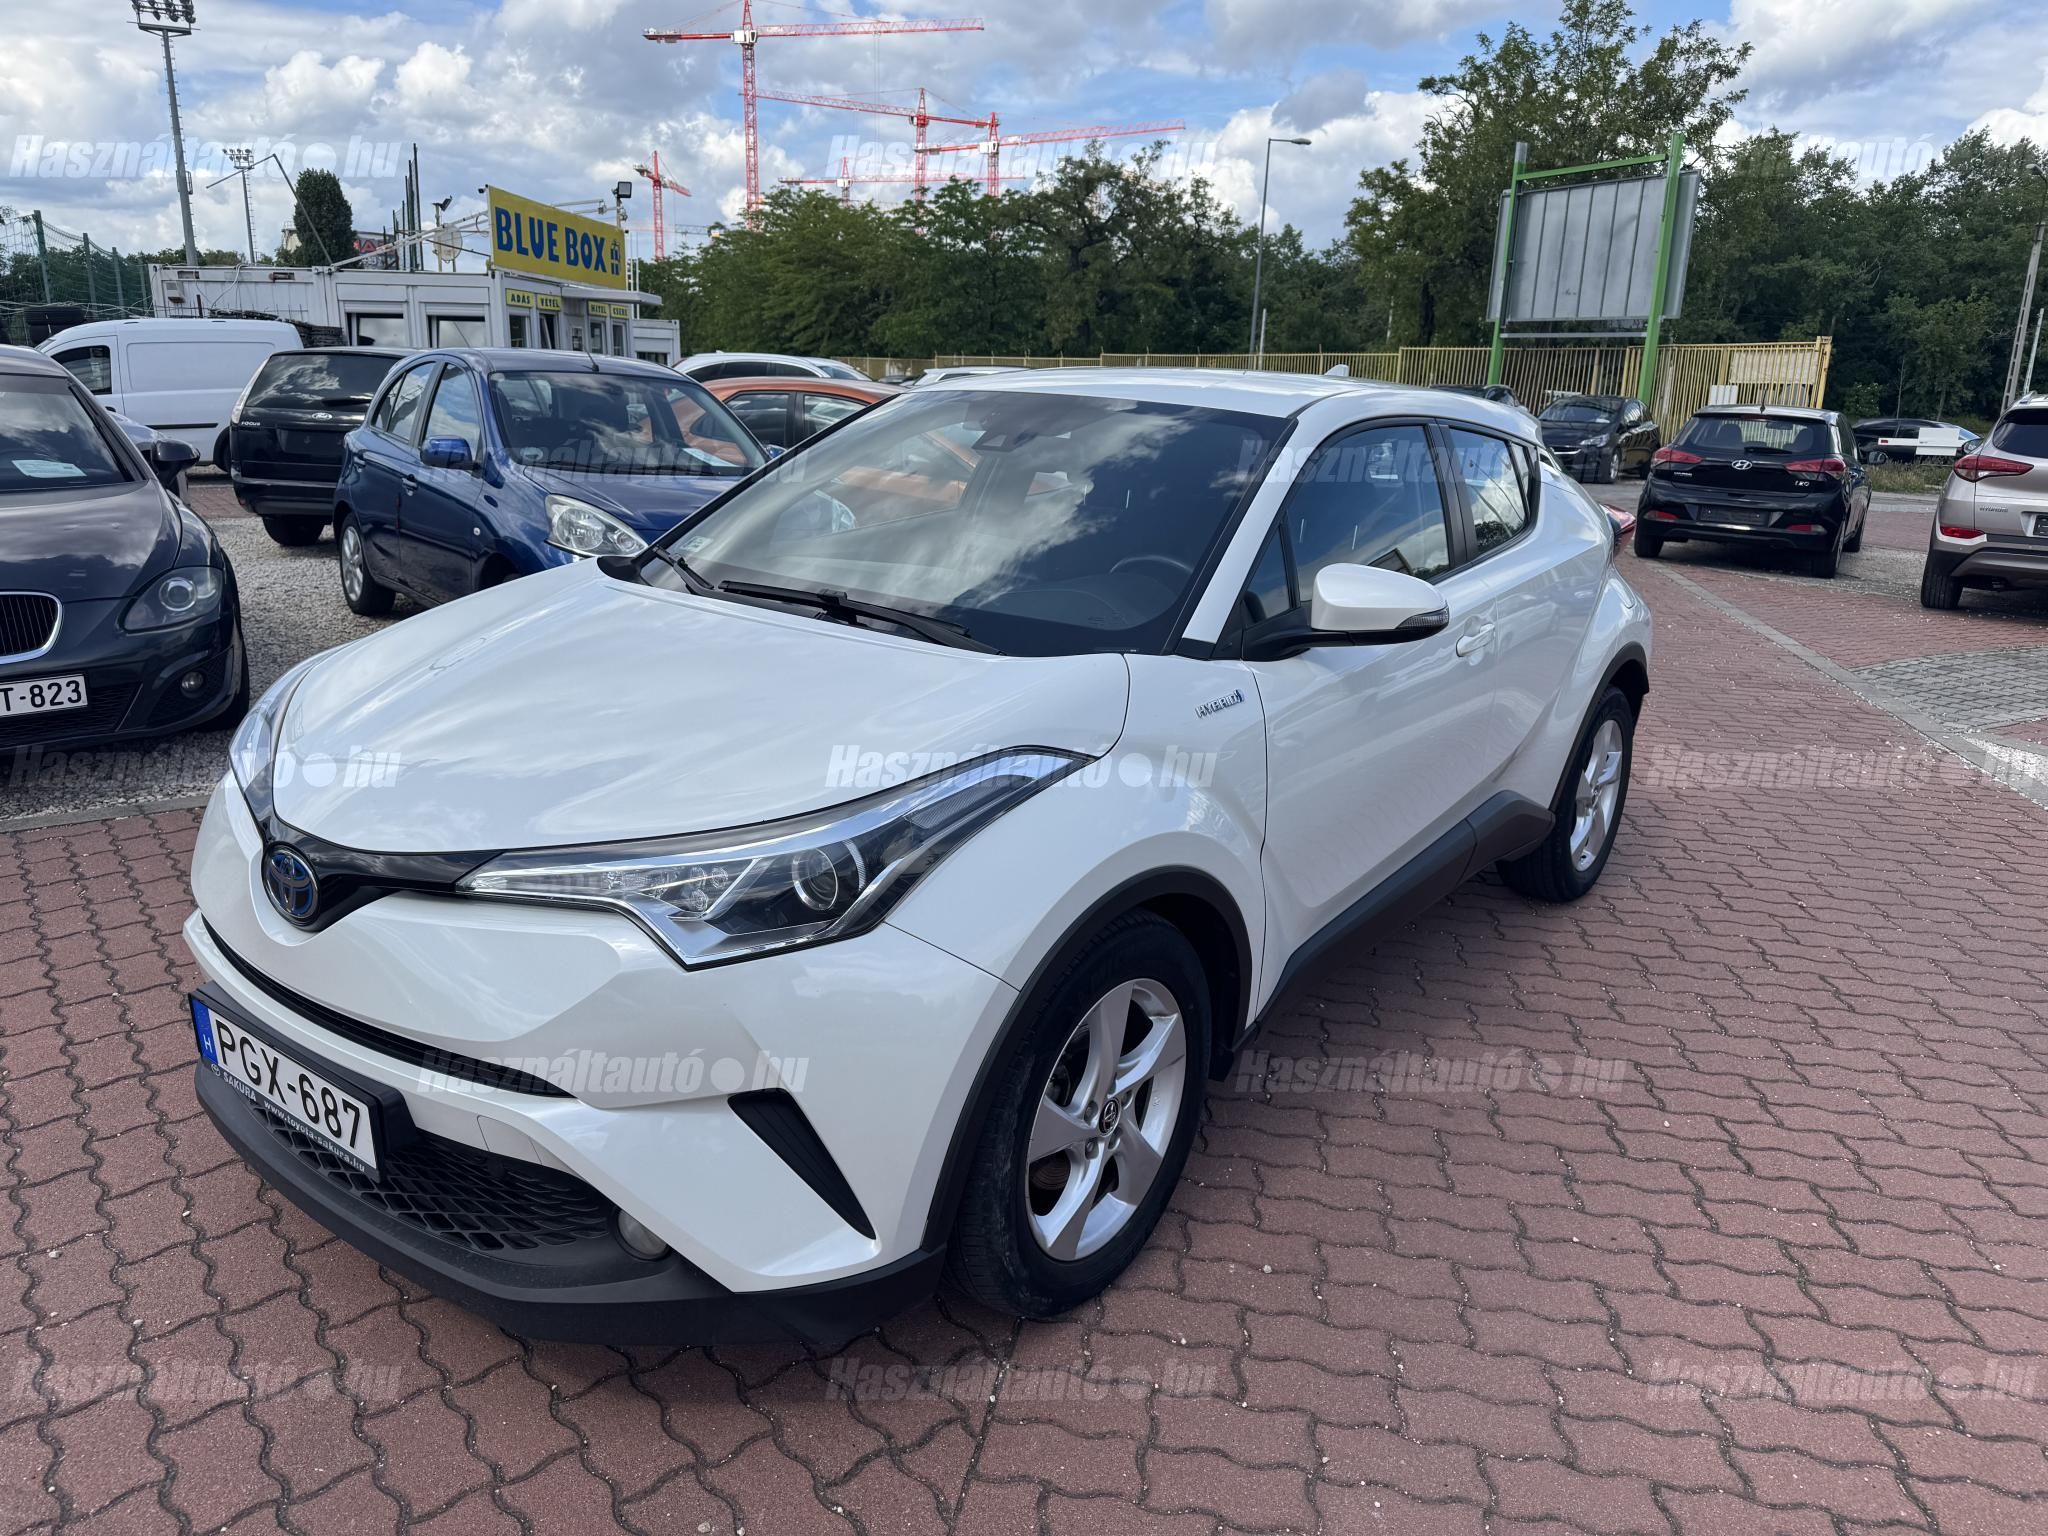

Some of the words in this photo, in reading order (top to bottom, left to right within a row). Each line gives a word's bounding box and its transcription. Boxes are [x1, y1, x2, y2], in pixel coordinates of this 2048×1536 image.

[495, 207, 560, 263] BLUE
[565, 227, 607, 273] BOX
[1194, 693, 1238, 719] HYBRID
[202, 1034, 213, 1054] H
[215, 1018, 361, 1149] PGX-687
[223, 1070, 257, 1103] SAKURA
[263, 1100, 366, 1174] www.toyota-sakura.hu
